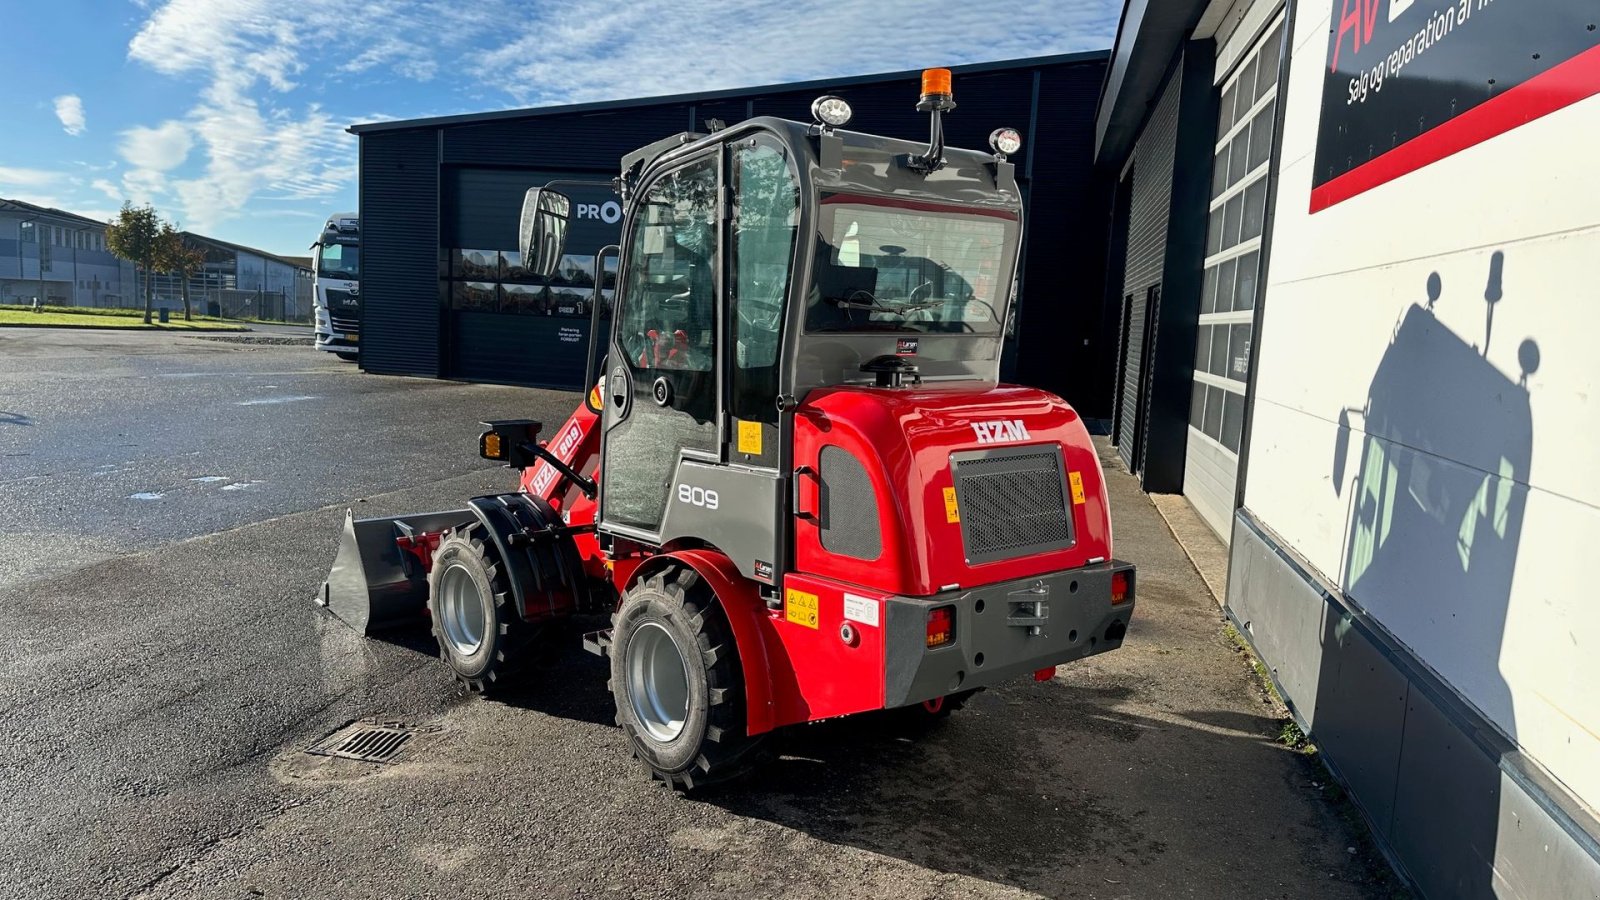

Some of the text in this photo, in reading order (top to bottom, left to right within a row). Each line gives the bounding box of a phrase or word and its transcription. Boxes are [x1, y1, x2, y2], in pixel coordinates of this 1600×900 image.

[1347, 69, 1369, 105] Salg
[1370, 61, 1384, 93] og
[1385, 6, 1455, 78] reparation
[560, 425, 580, 457] 809
[970, 419, 1031, 444] HZM
[678, 484, 719, 510] 809
